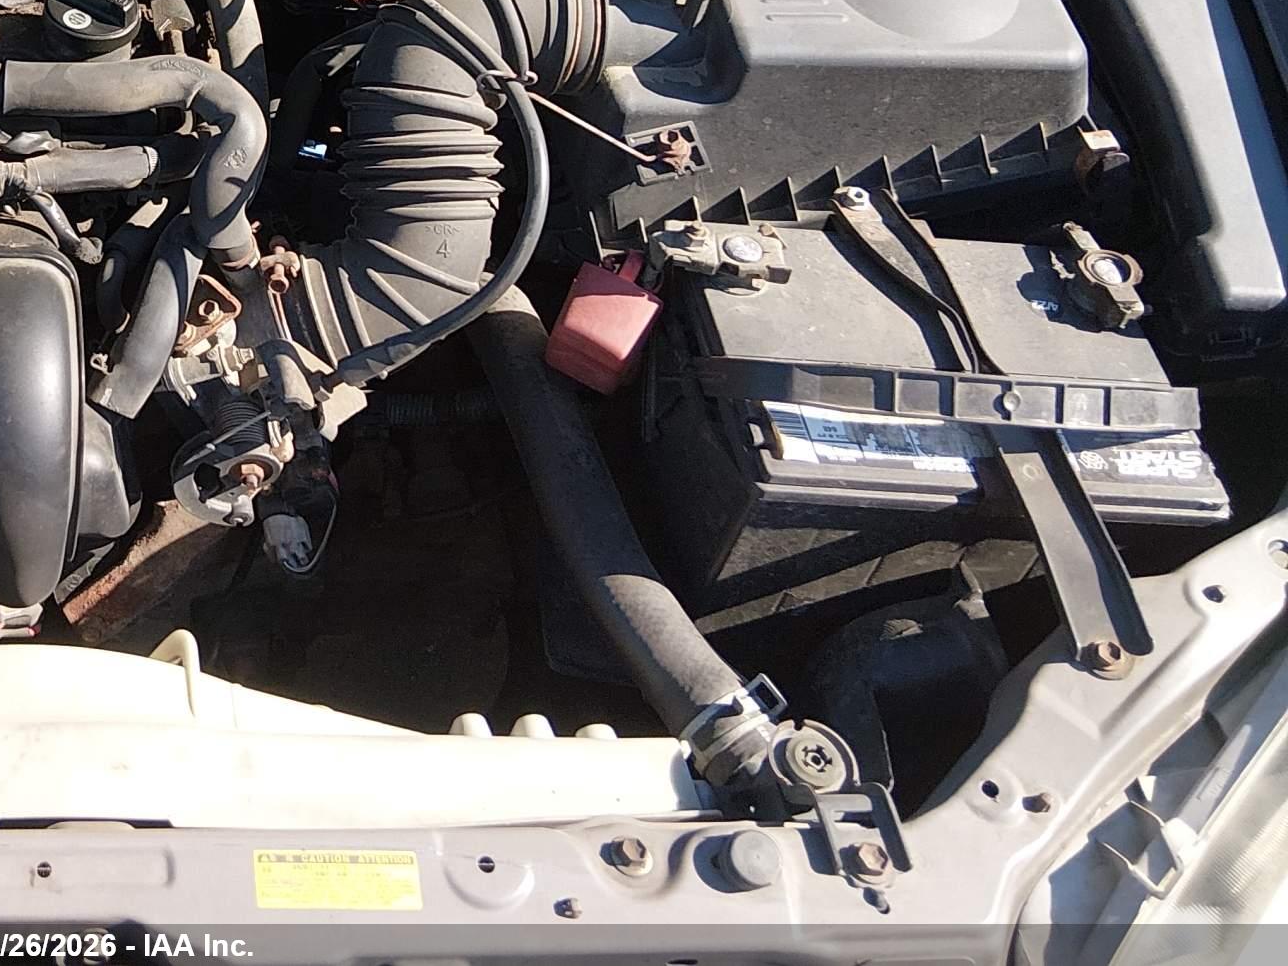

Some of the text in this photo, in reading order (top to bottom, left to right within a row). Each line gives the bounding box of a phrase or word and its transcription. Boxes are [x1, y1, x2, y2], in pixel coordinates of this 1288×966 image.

[435, 239, 450, 259] 4
[1119, 451, 1202, 466] START
[1118, 463, 1198, 479] SUPER
[357, 853, 411, 864] ATTENTION
